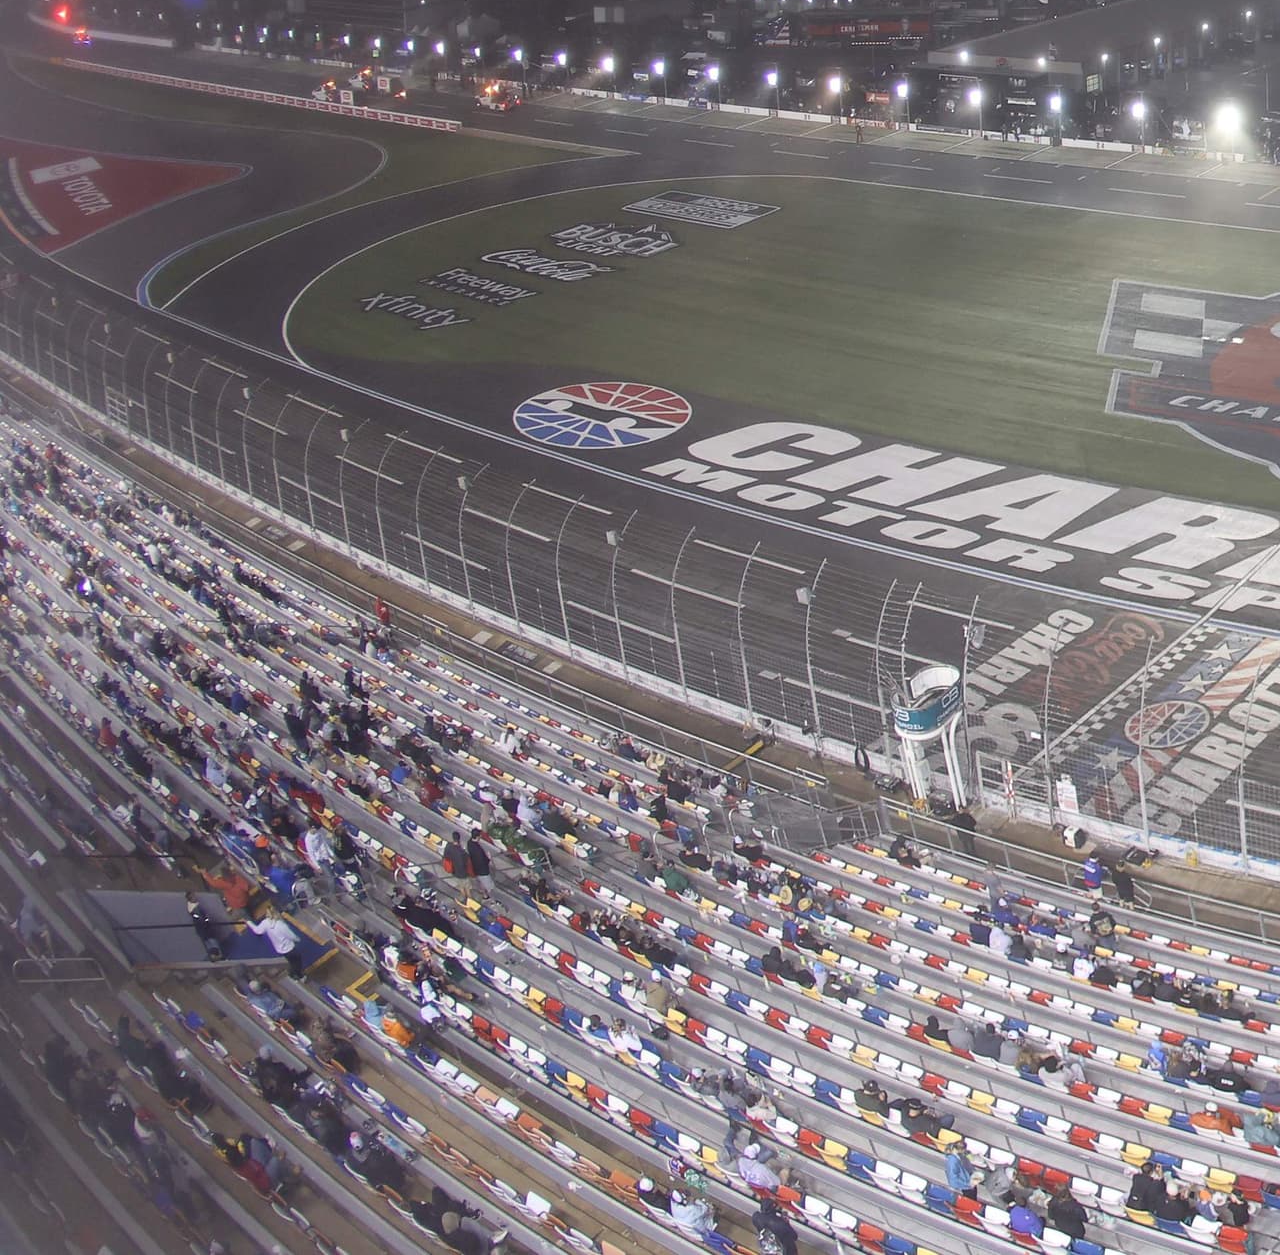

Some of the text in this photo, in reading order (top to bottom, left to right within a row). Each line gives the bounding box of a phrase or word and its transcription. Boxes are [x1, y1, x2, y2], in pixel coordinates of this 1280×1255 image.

[61, 175, 113, 216] TOYOTA
[551, 224, 679, 257] BUSCH
[557, 240, 621, 256] LIGHT
[437, 268, 538, 300] Freeway
[361, 292, 471, 330] xfinity
[641, 458, 1076, 574] MOTOR
